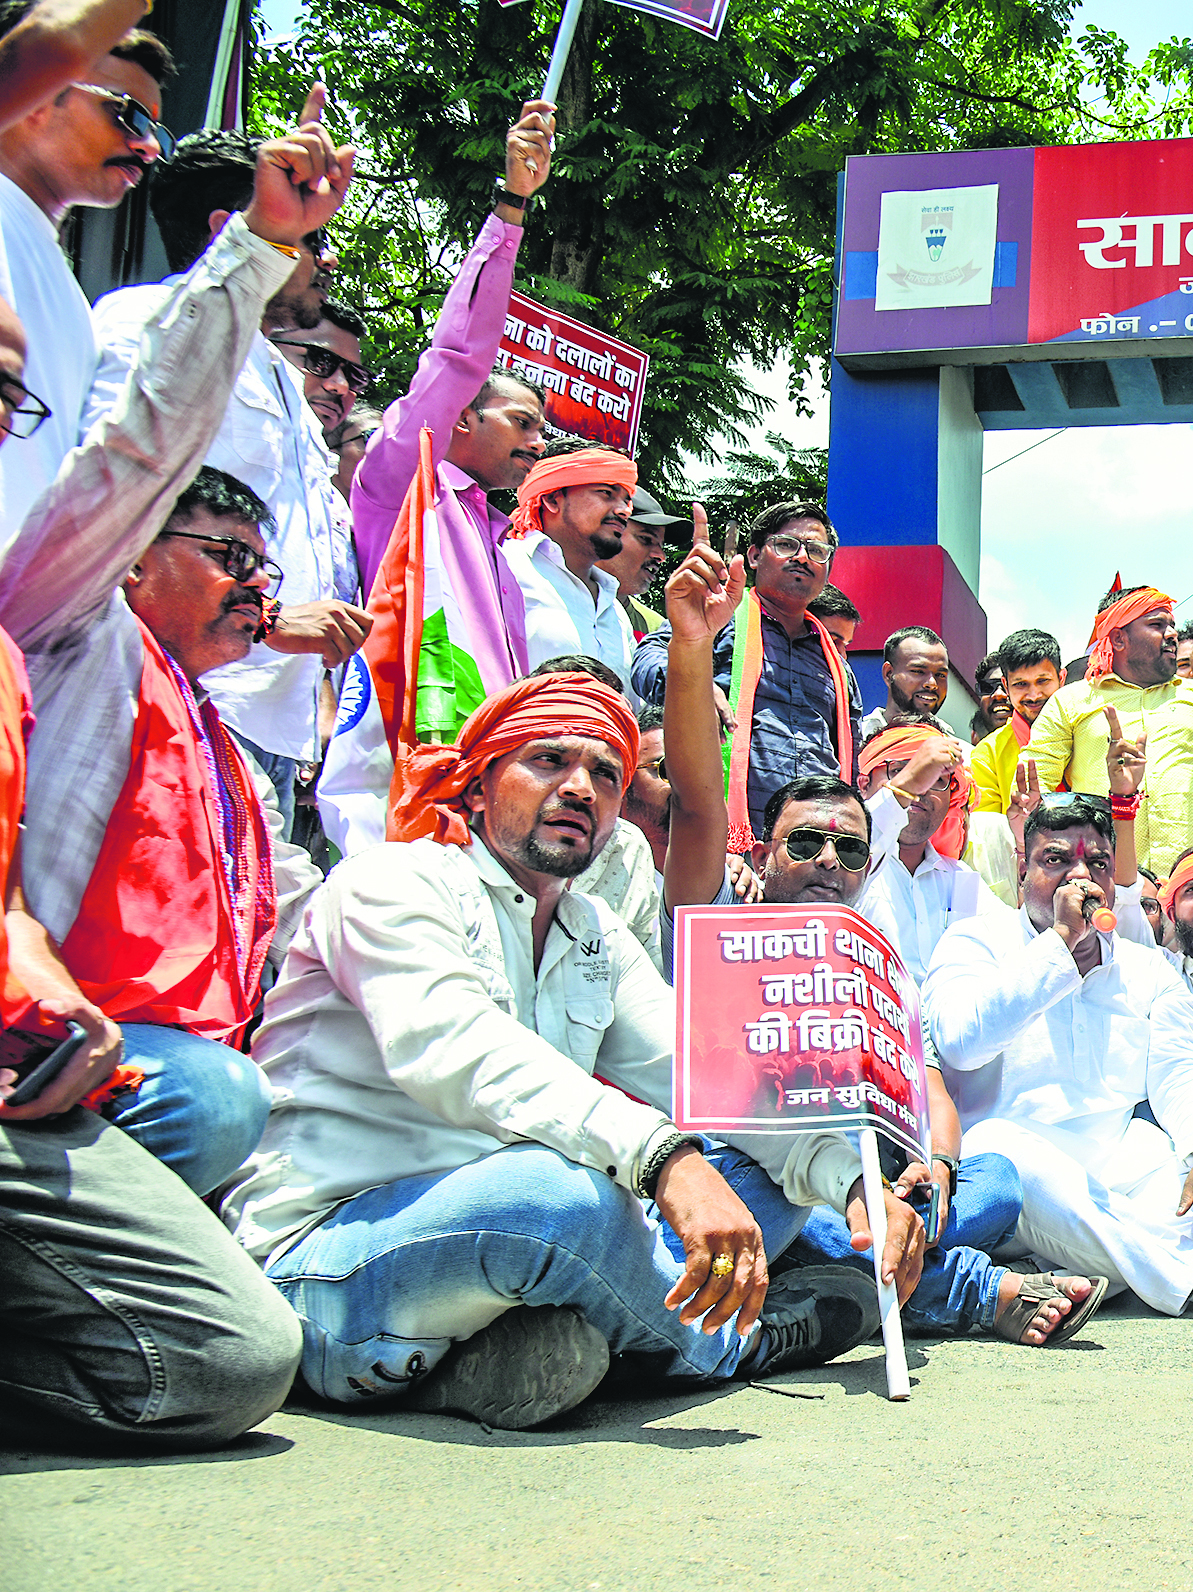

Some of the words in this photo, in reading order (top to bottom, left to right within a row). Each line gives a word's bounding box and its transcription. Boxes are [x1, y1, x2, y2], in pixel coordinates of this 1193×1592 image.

[1080, 312, 1141, 335] फोन
[526, 323, 555, 356] को
[555, 335, 616, 381] दलालों
[614, 361, 638, 392] का
[569, 374, 597, 407] बंद
[597, 388, 632, 422] करो
[718, 919, 829, 963] साकची
[833, 928, 885, 981] थाना
[759, 962, 871, 1010] नशीली
[743, 1011, 793, 1055] की
[795, 1009, 871, 1054] बिक्री
[870, 1023, 898, 1072] बंद
[784, 1087, 831, 1106] जन
[834, 1081, 899, 1117] सुविधा
[897, 1101, 918, 1131] मंच
